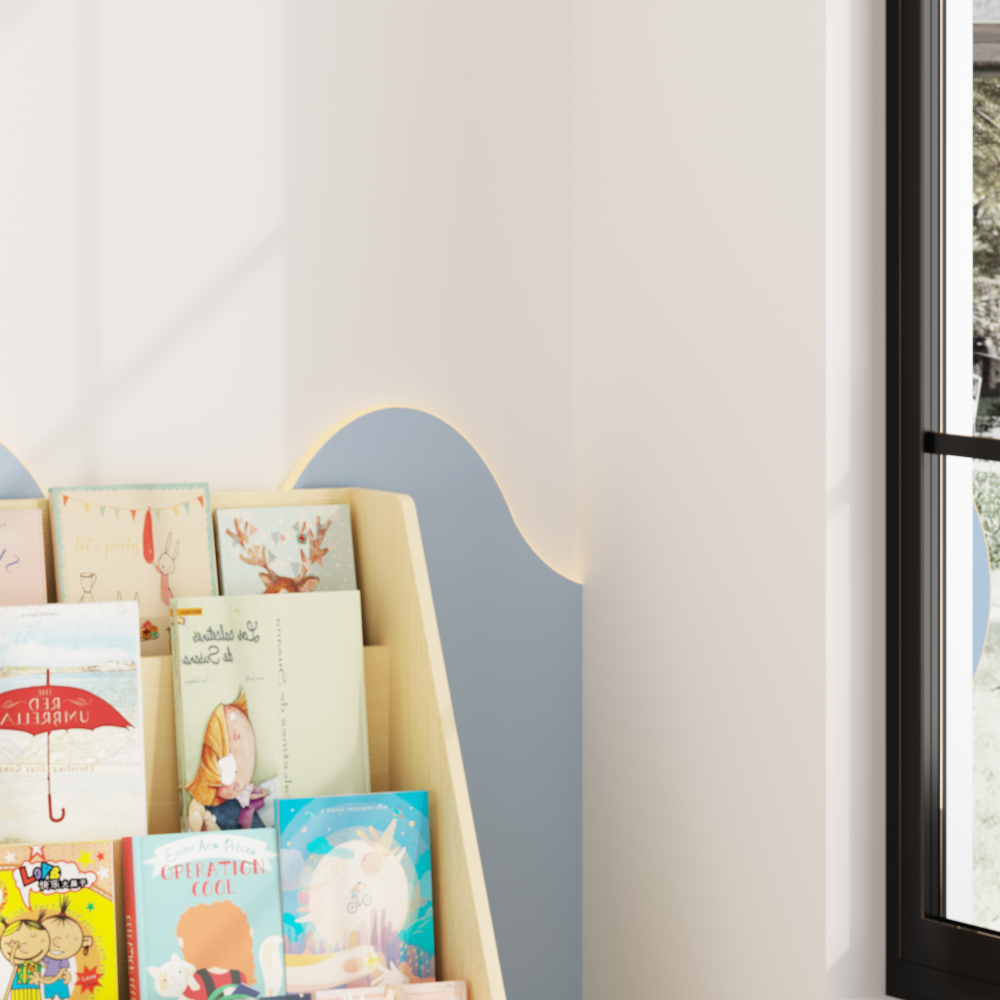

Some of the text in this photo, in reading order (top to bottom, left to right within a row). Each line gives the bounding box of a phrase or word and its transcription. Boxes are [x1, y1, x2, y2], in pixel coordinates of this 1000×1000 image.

[104, 540, 141, 560] party
[161, 859, 265, 881] OPERATION
[191, 879, 236, 898] COOL
